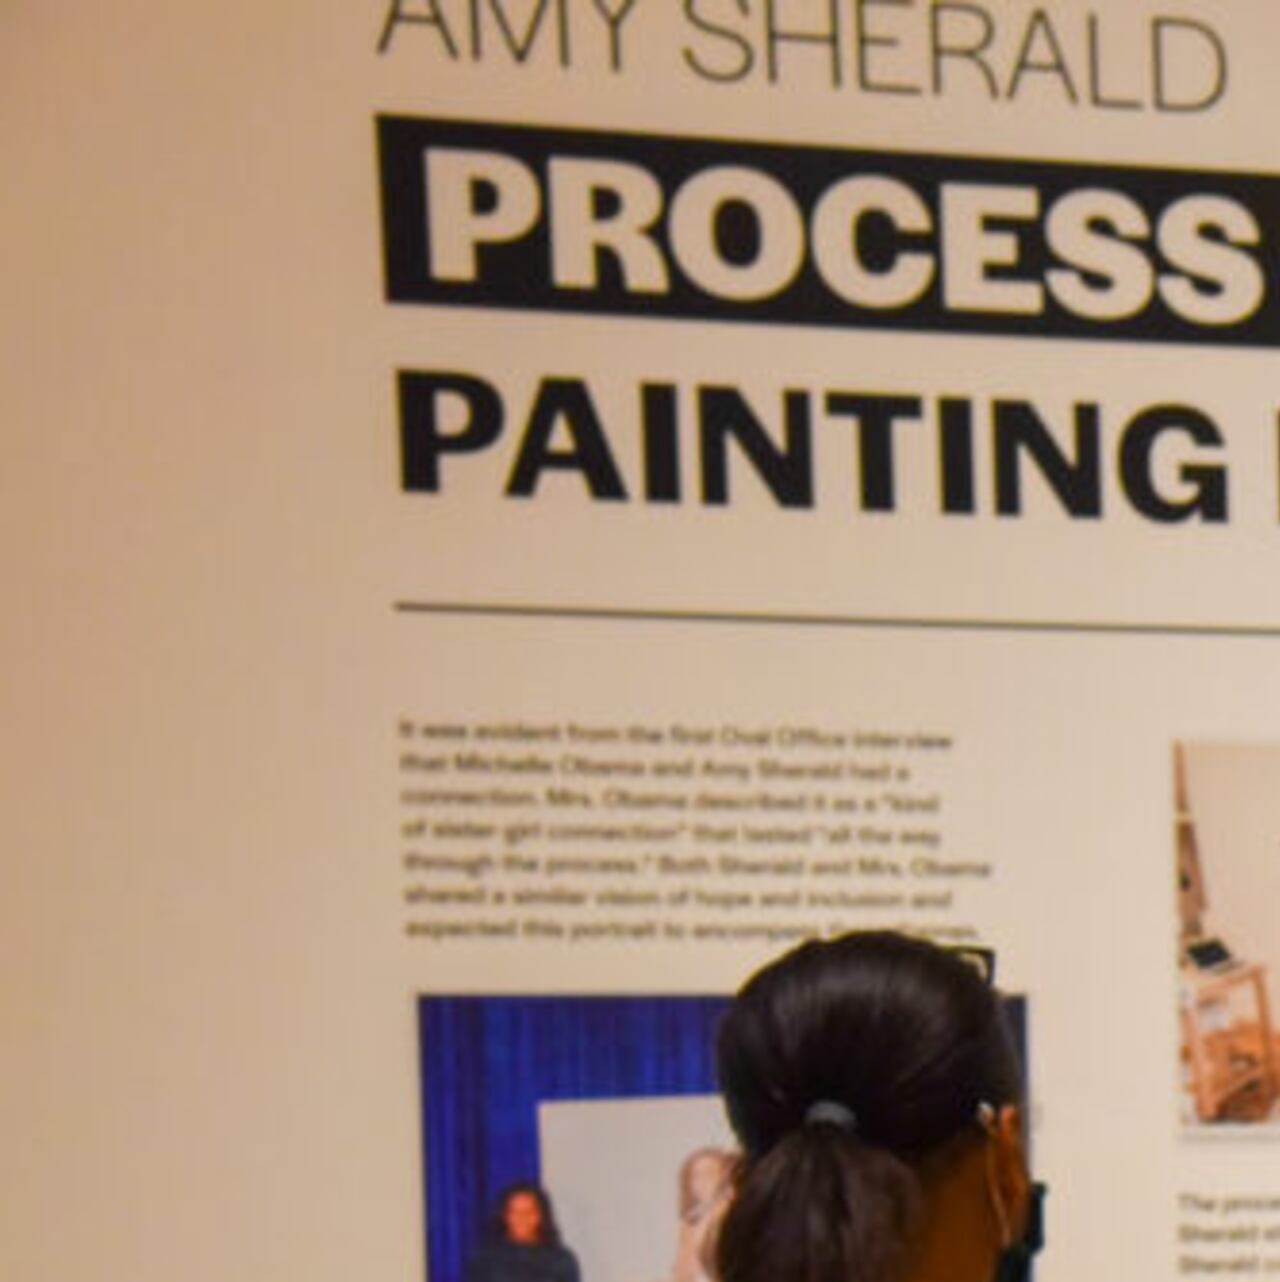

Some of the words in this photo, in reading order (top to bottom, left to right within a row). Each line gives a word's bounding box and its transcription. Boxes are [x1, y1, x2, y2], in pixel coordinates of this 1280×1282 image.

[376, 0, 636, 72] AMY
[682, 0, 1228, 112] SHERALD
[424, 147, 1265, 326] PROCESS
[395, 368, 1229, 524] PAINTING
